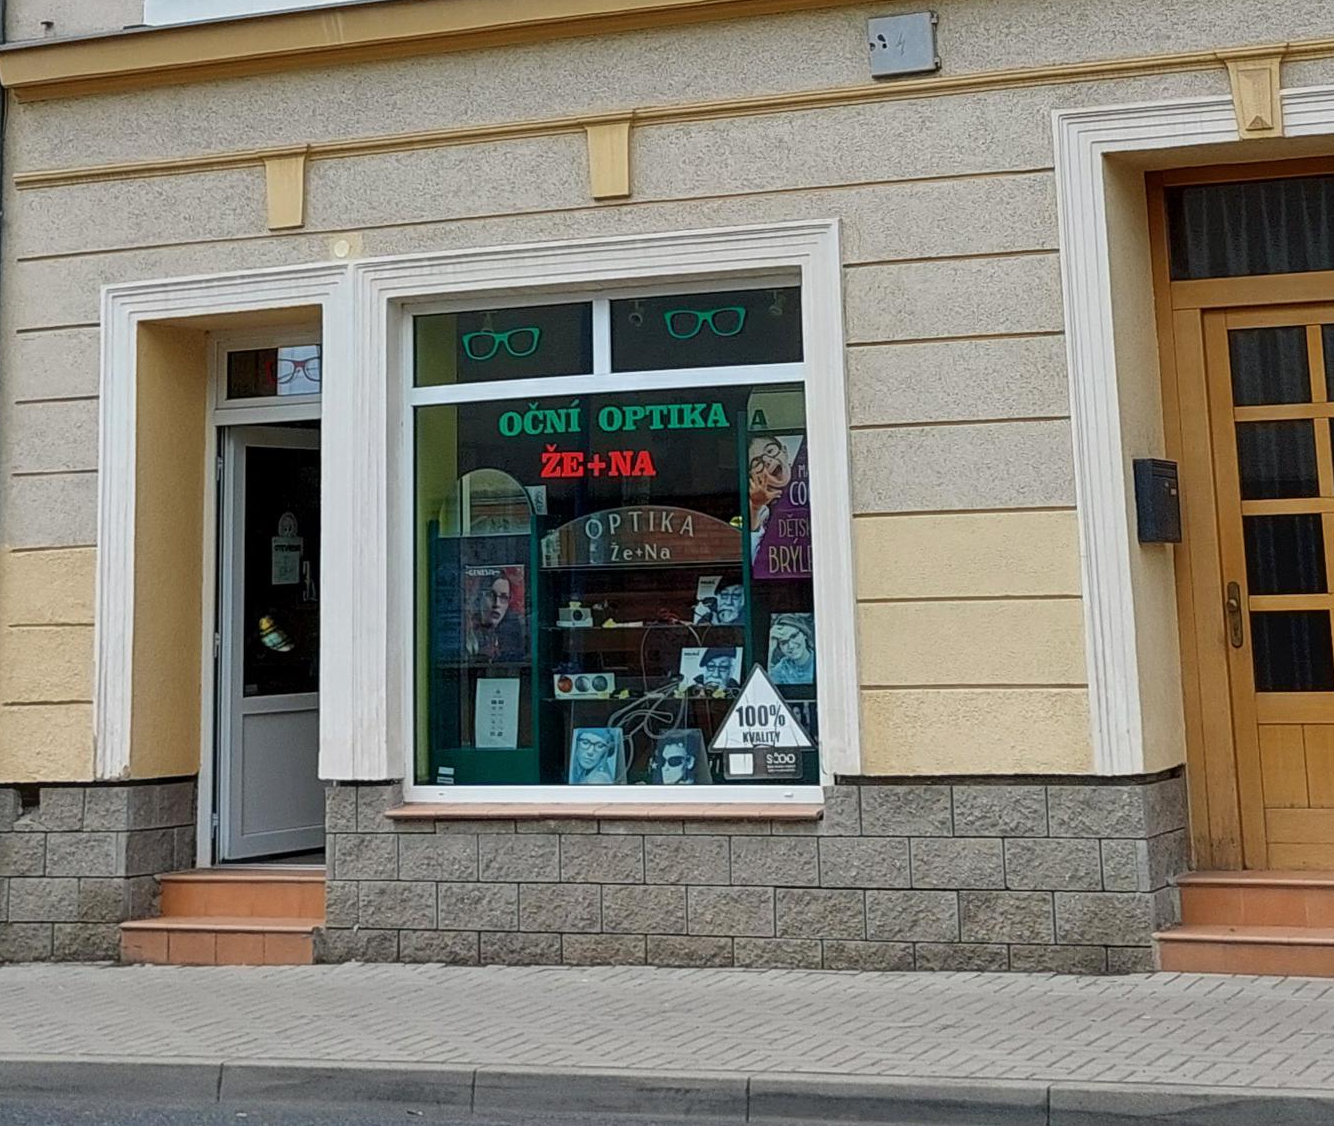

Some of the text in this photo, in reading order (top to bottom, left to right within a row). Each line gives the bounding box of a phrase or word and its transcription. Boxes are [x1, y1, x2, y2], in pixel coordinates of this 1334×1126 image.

[499, 399, 730, 437] OČNÍ OPTIKA
[540, 443, 656, 478] ŽE+NA
[585, 511, 694, 540] OPTIKA
[610, 541, 671, 562] Že+Na
[735, 704, 786, 727] 100%
[742, 730, 781, 744] KVALITY
